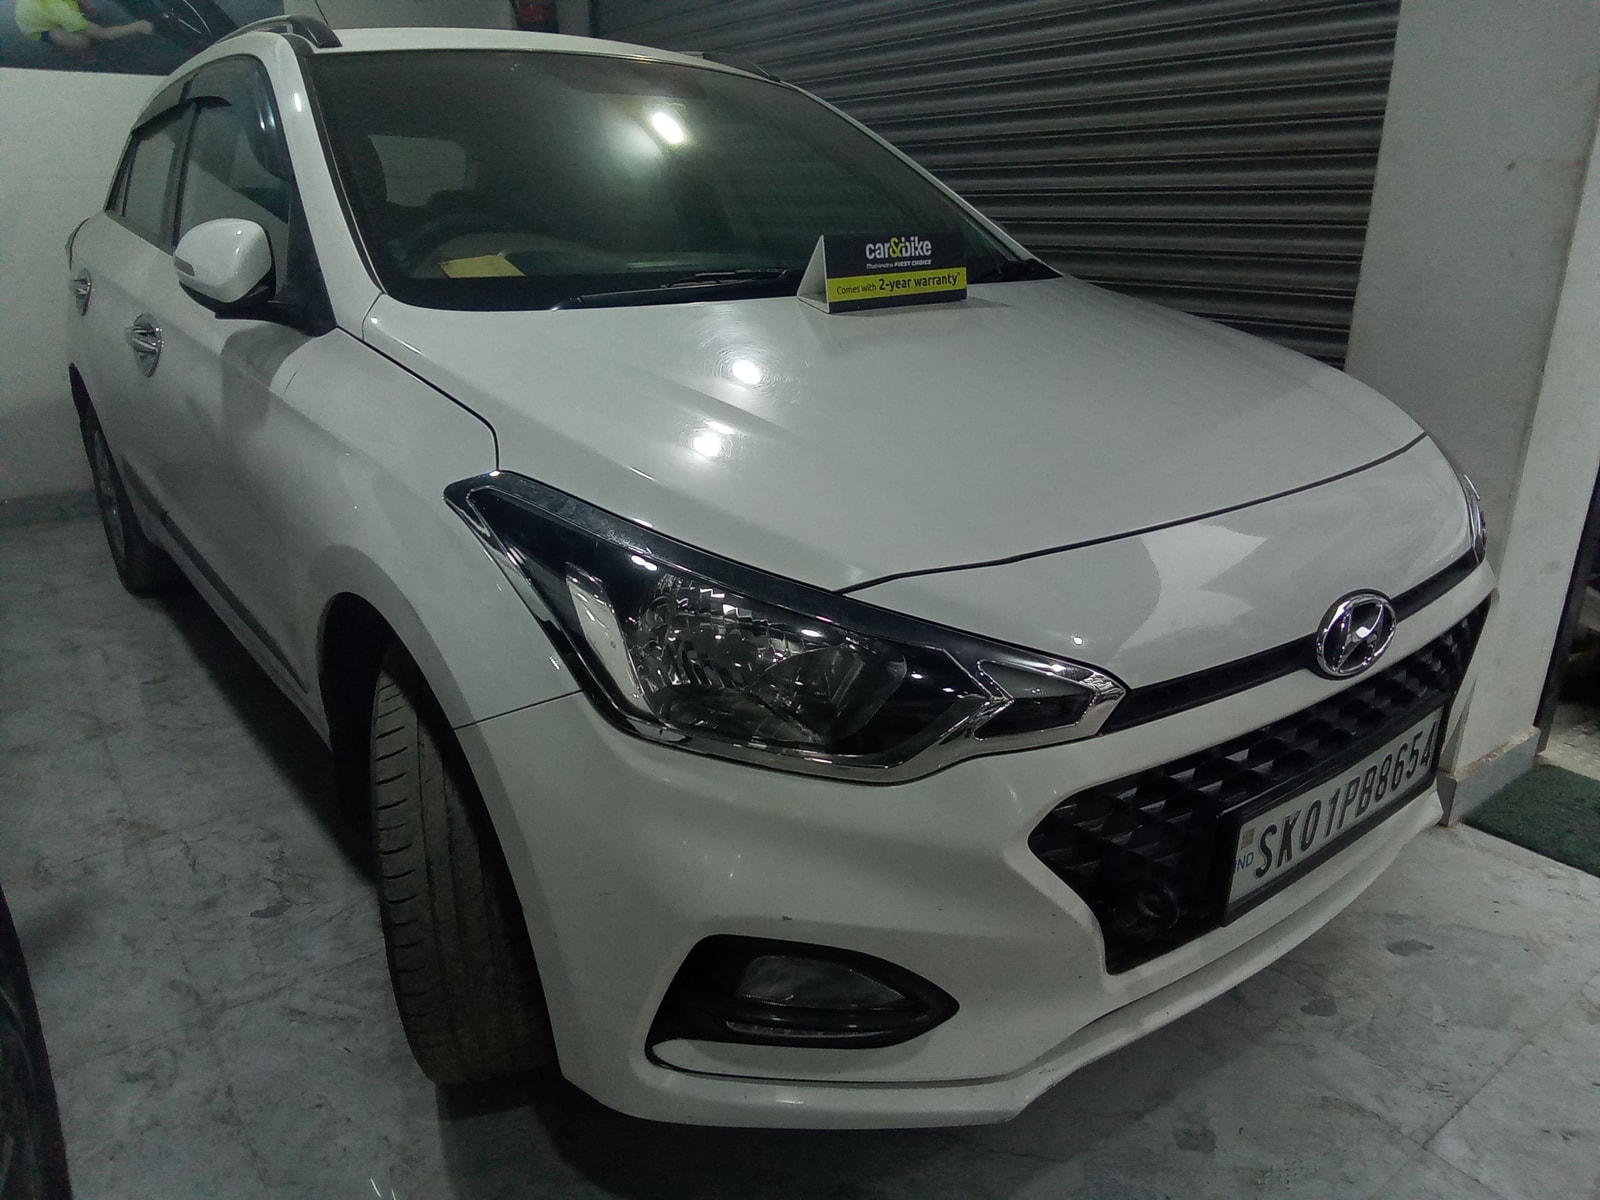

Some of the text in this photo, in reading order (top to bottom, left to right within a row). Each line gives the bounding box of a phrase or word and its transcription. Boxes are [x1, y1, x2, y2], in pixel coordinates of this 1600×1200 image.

[866, 236, 932, 260] car&bike
[837, 285, 861, 295] Comes
[861, 283, 877, 293] with
[879, 277, 912, 292] 2-year
[1255, 721, 1438, 879] SK01PB8654
